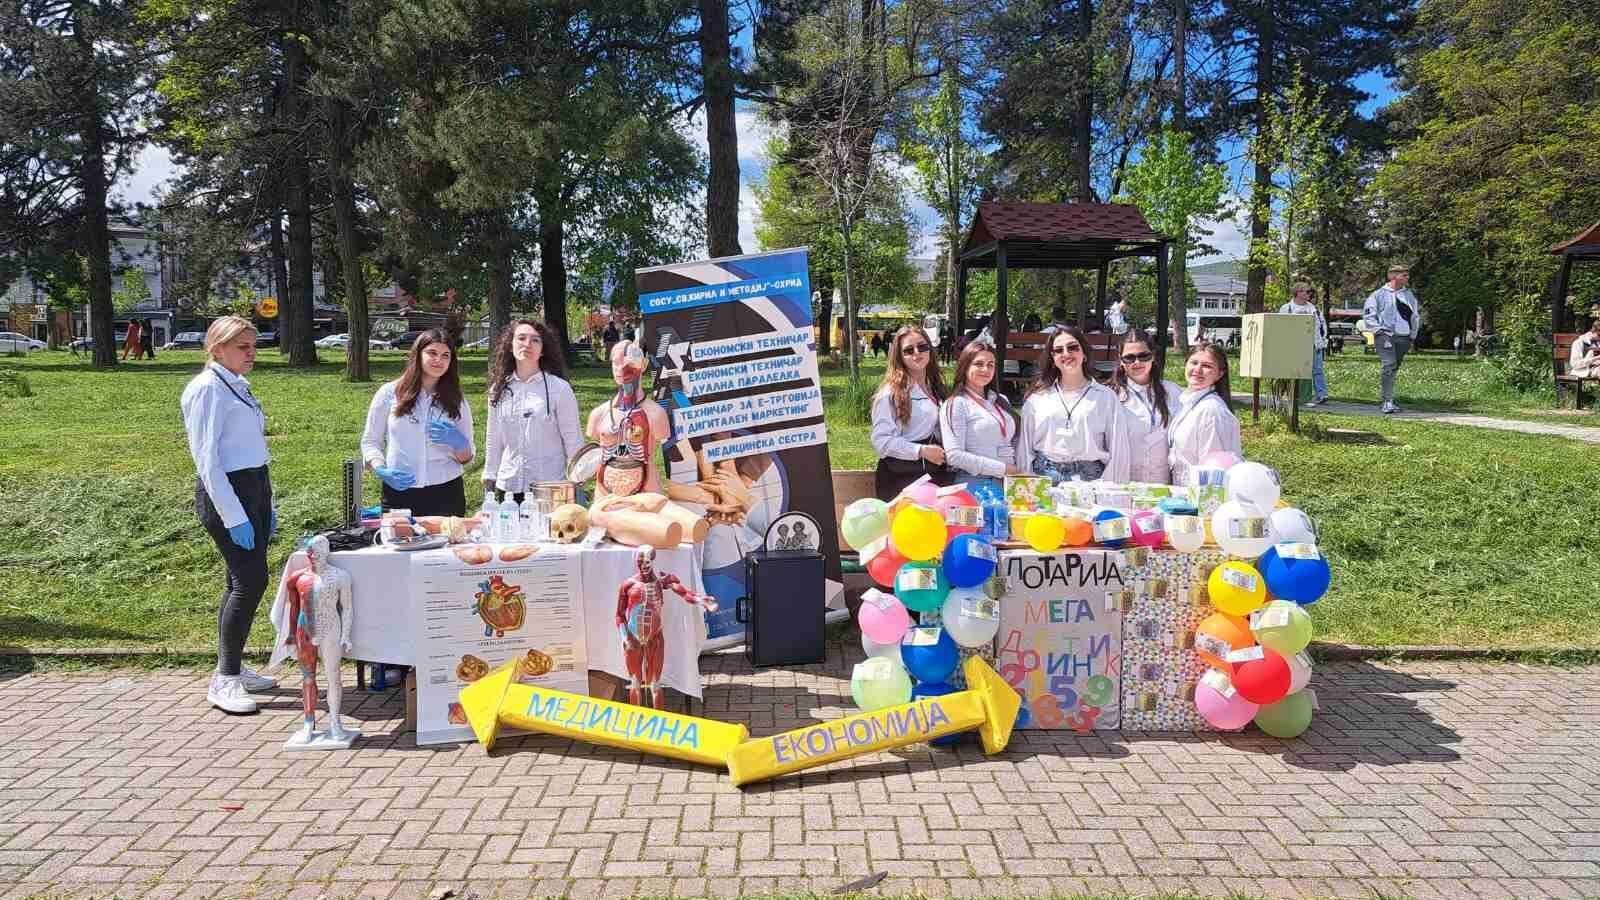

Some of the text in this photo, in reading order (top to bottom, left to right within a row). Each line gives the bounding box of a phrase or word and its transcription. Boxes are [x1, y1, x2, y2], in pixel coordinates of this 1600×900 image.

[720, 286, 727, 297] И
[694, 332, 809, 358] ЕКОНОМСКИ ТЕХНИЧАР
[688, 356, 803, 382] ЕКОНОМСКИ ТЕХНИЧАР
[691, 370, 801, 397] ДУАЛНА ПАРАЛЕЛКА
[681, 390, 819, 420] ТЕХНИЧАР ЗА Е-ТРГОВИЈА
[675, 404, 809, 435] И ДИГИТАЛЕН МАРКЕТИНГ
[707, 431, 817, 458] МЕДИЦИНСКА СЕСТРА
[1007, 552, 1124, 589] ЛОТАРИЈА
[1024, 599, 1095, 624] МЕГА
[526, 692, 700, 750] МЕДИЦИНА
[773, 701, 952, 765] ЕКОНОМИЈА
